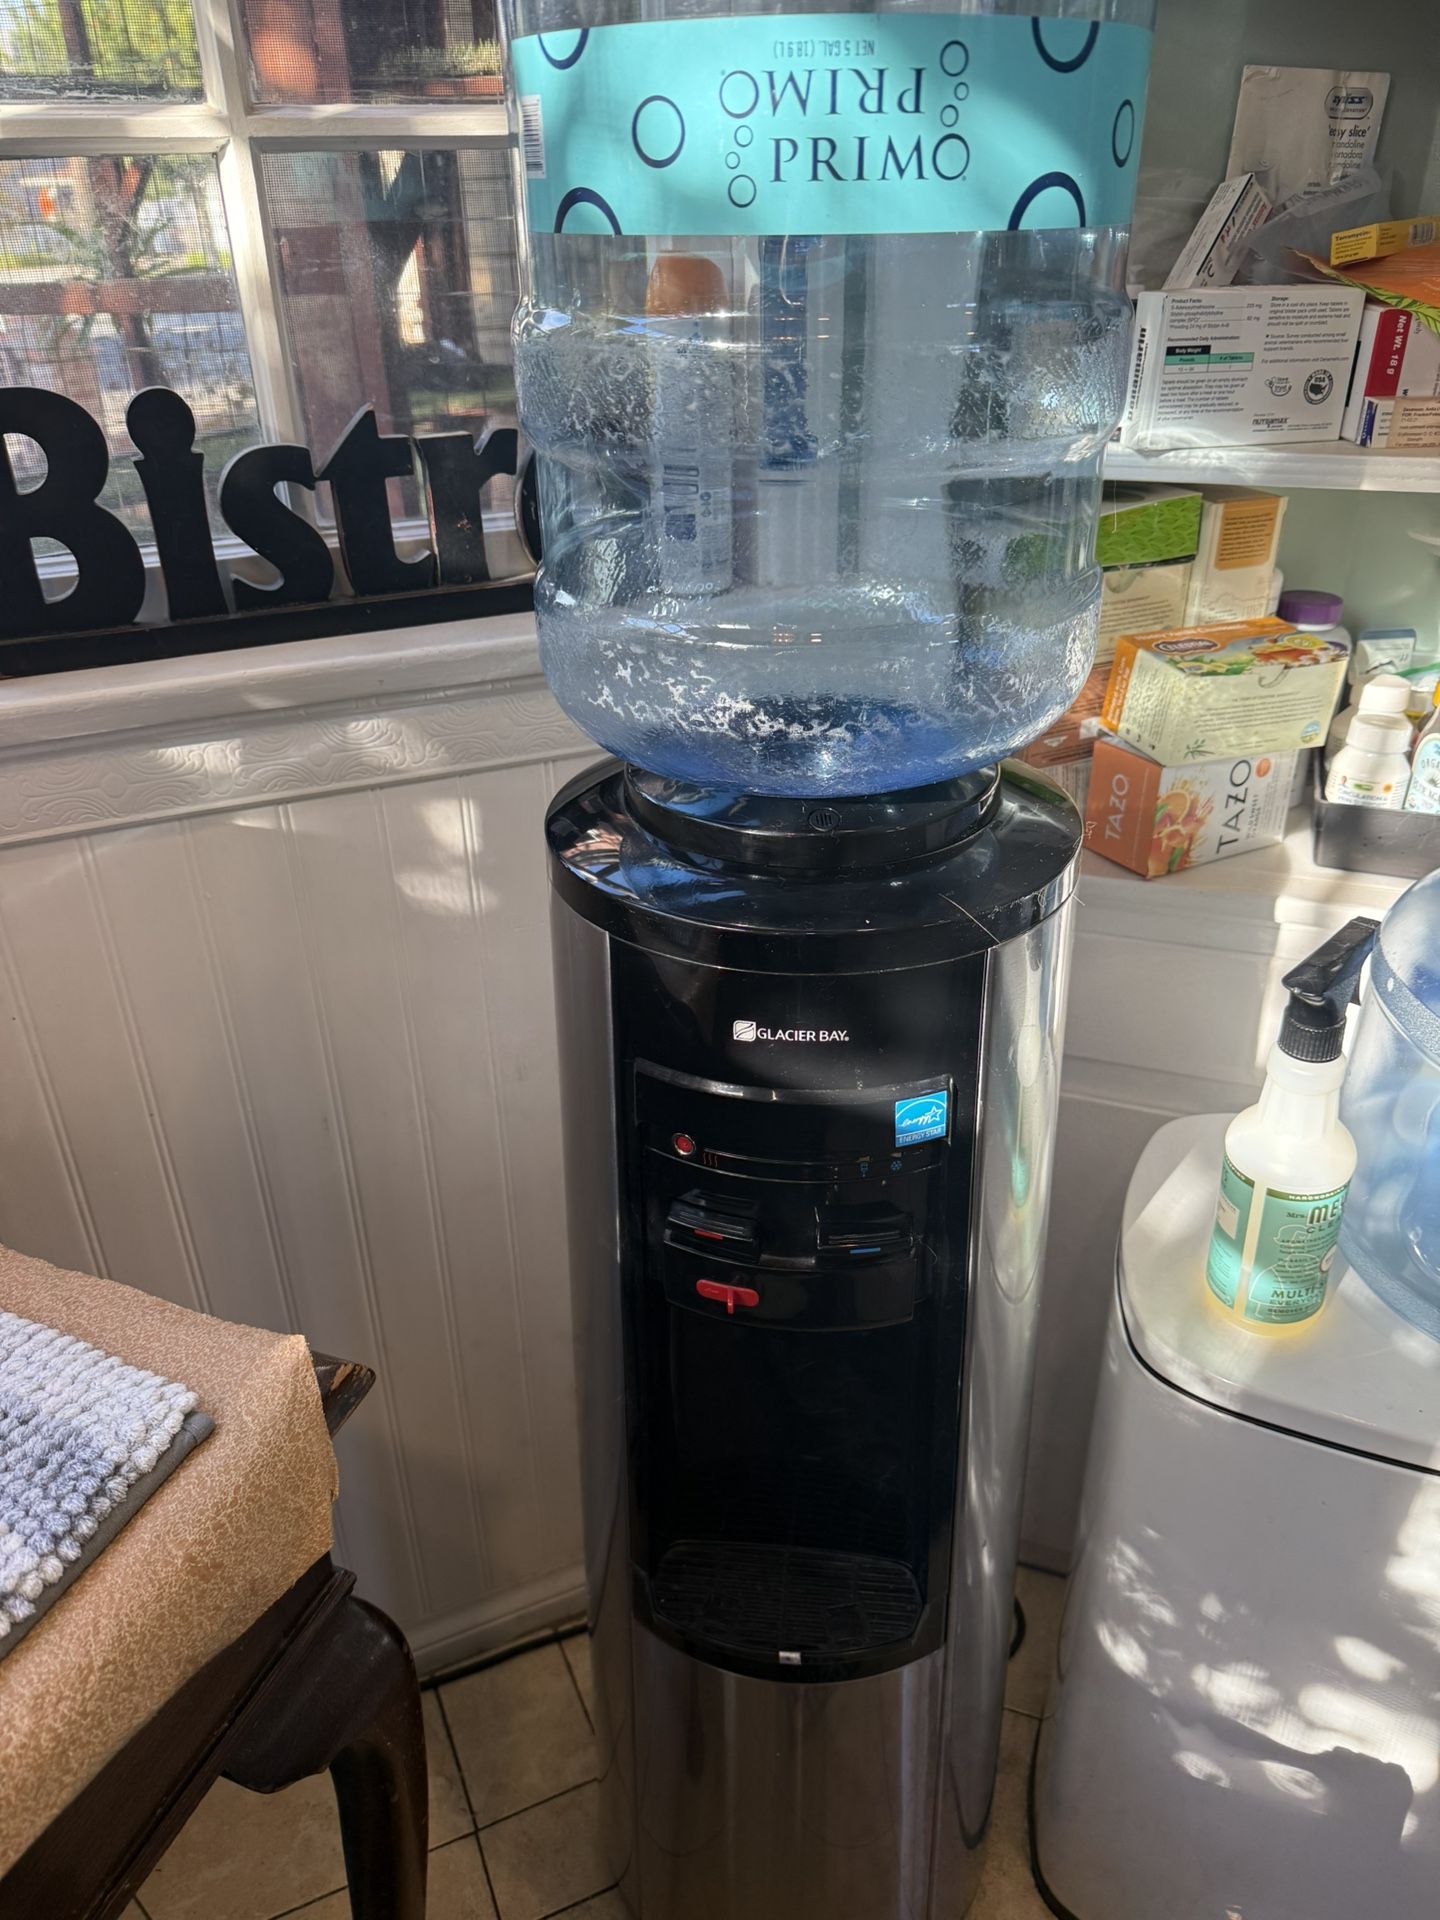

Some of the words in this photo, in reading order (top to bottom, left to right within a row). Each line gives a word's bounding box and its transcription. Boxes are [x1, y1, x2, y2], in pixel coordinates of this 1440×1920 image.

[843, 39, 851, 56] 5
[855, 39, 875, 56] NET
[719, 67, 927, 119] PRIMO
[768, 133, 971, 183] PRIMO
[1397, 314, 1407, 332] Net
[1389, 353, 1399, 367] 18
[0, 386, 541, 634] Bistr
[1105, 773, 1129, 840] TAZO
[1216, 759, 1253, 853] TAZO
[756, 1026, 817, 1042] GLACIER
[898, 1132, 926, 1144] ENERGY
[925, 1127, 942, 1138] STAR
